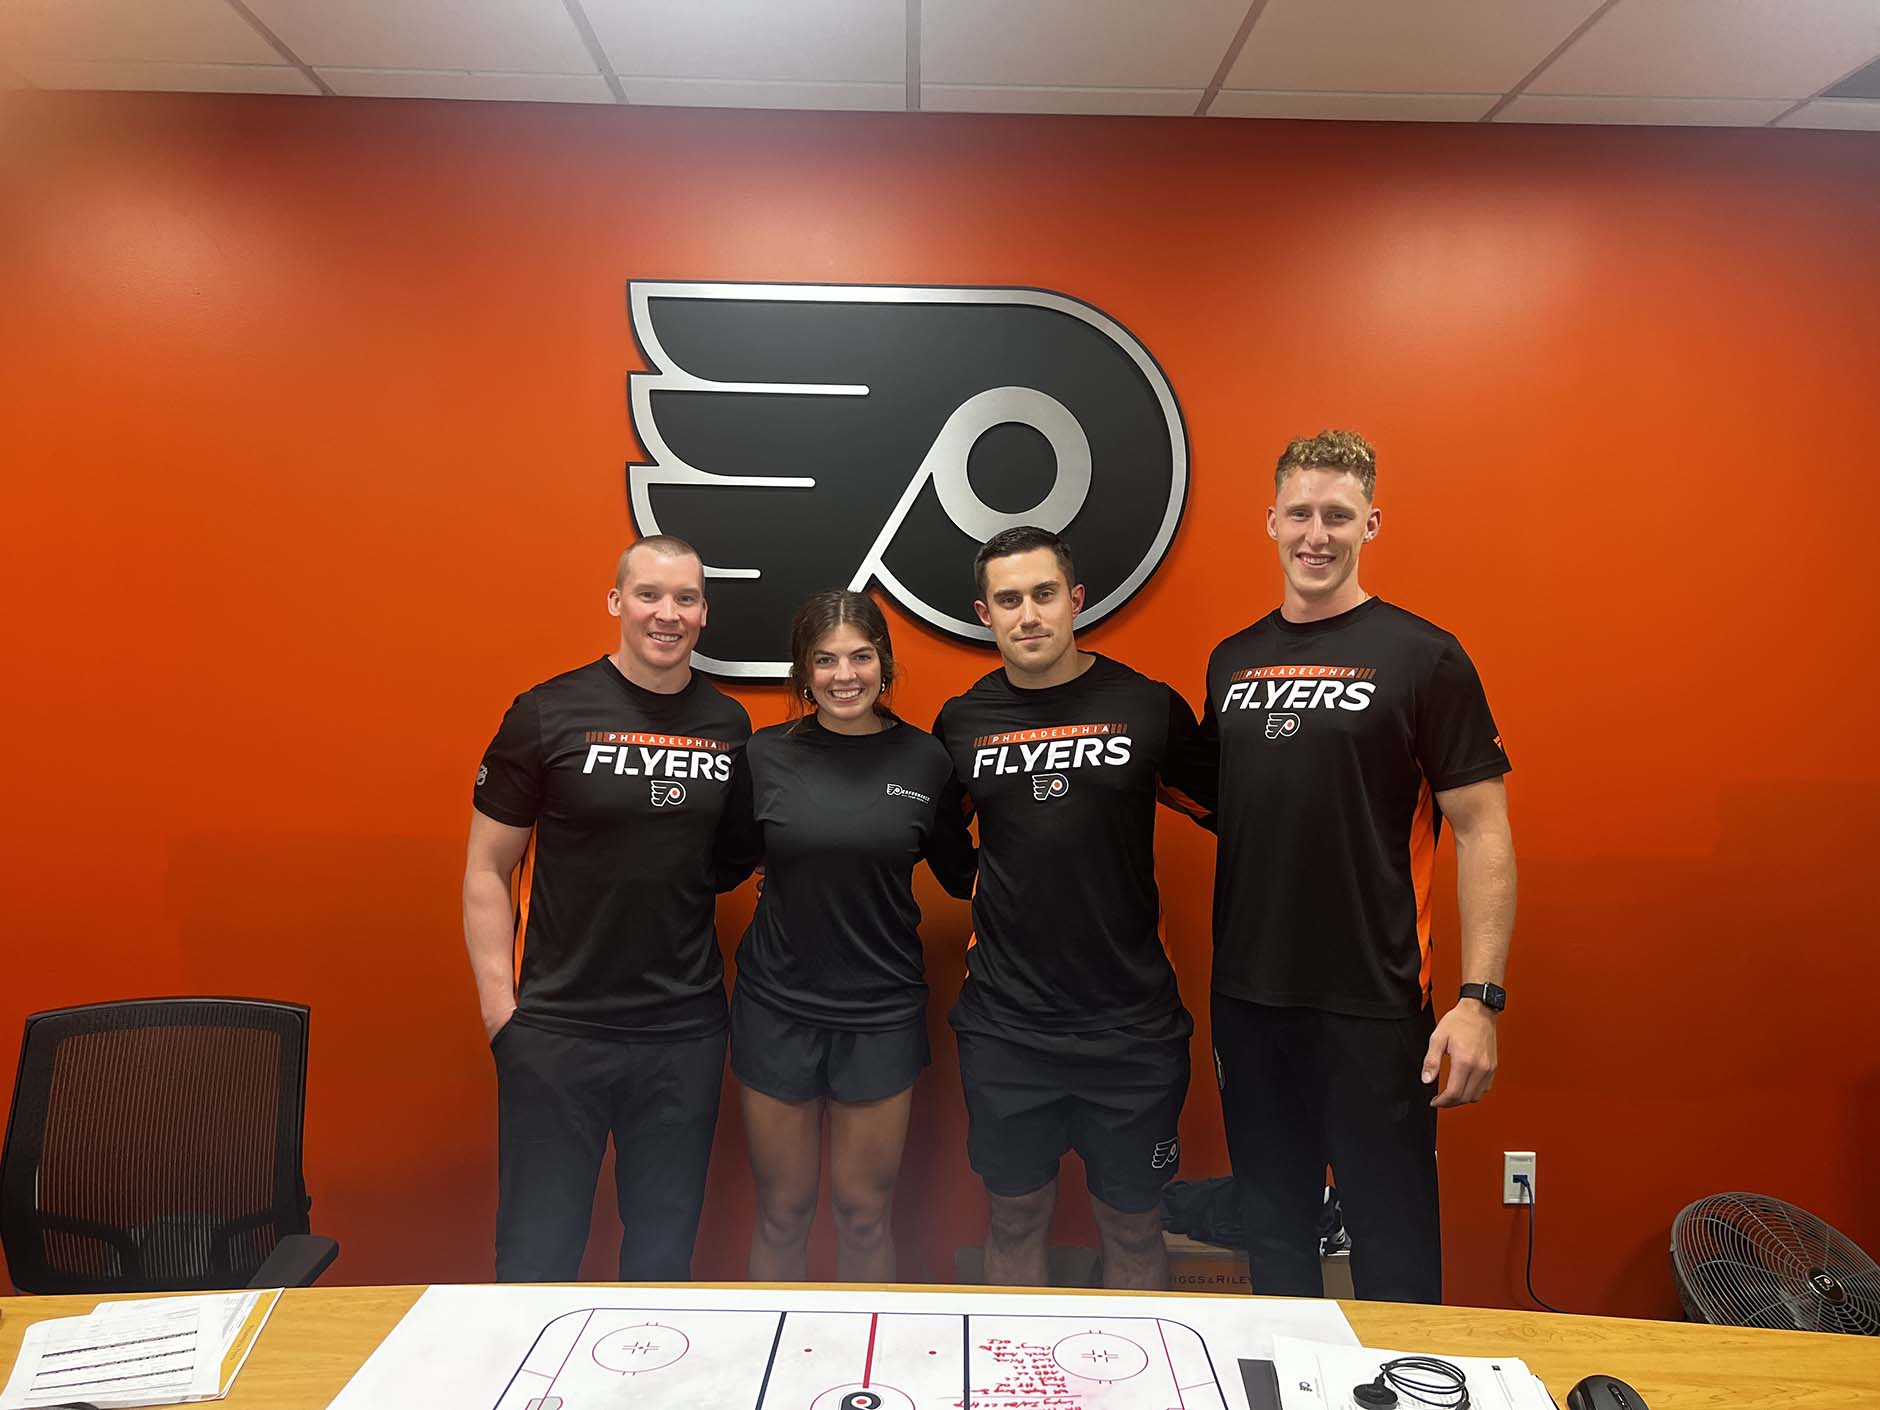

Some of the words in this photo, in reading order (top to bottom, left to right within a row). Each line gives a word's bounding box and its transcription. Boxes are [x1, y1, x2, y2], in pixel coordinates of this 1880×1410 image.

[1245, 667, 1357, 678] PHILADELPHIA
[1221, 680, 1377, 711] FLYERS
[608, 733, 718, 749] PHILADELPHIA
[992, 725, 1110, 744] PHILADELPHIA
[582, 744, 732, 782] FLYERS
[972, 736, 1132, 778] FLYERS
